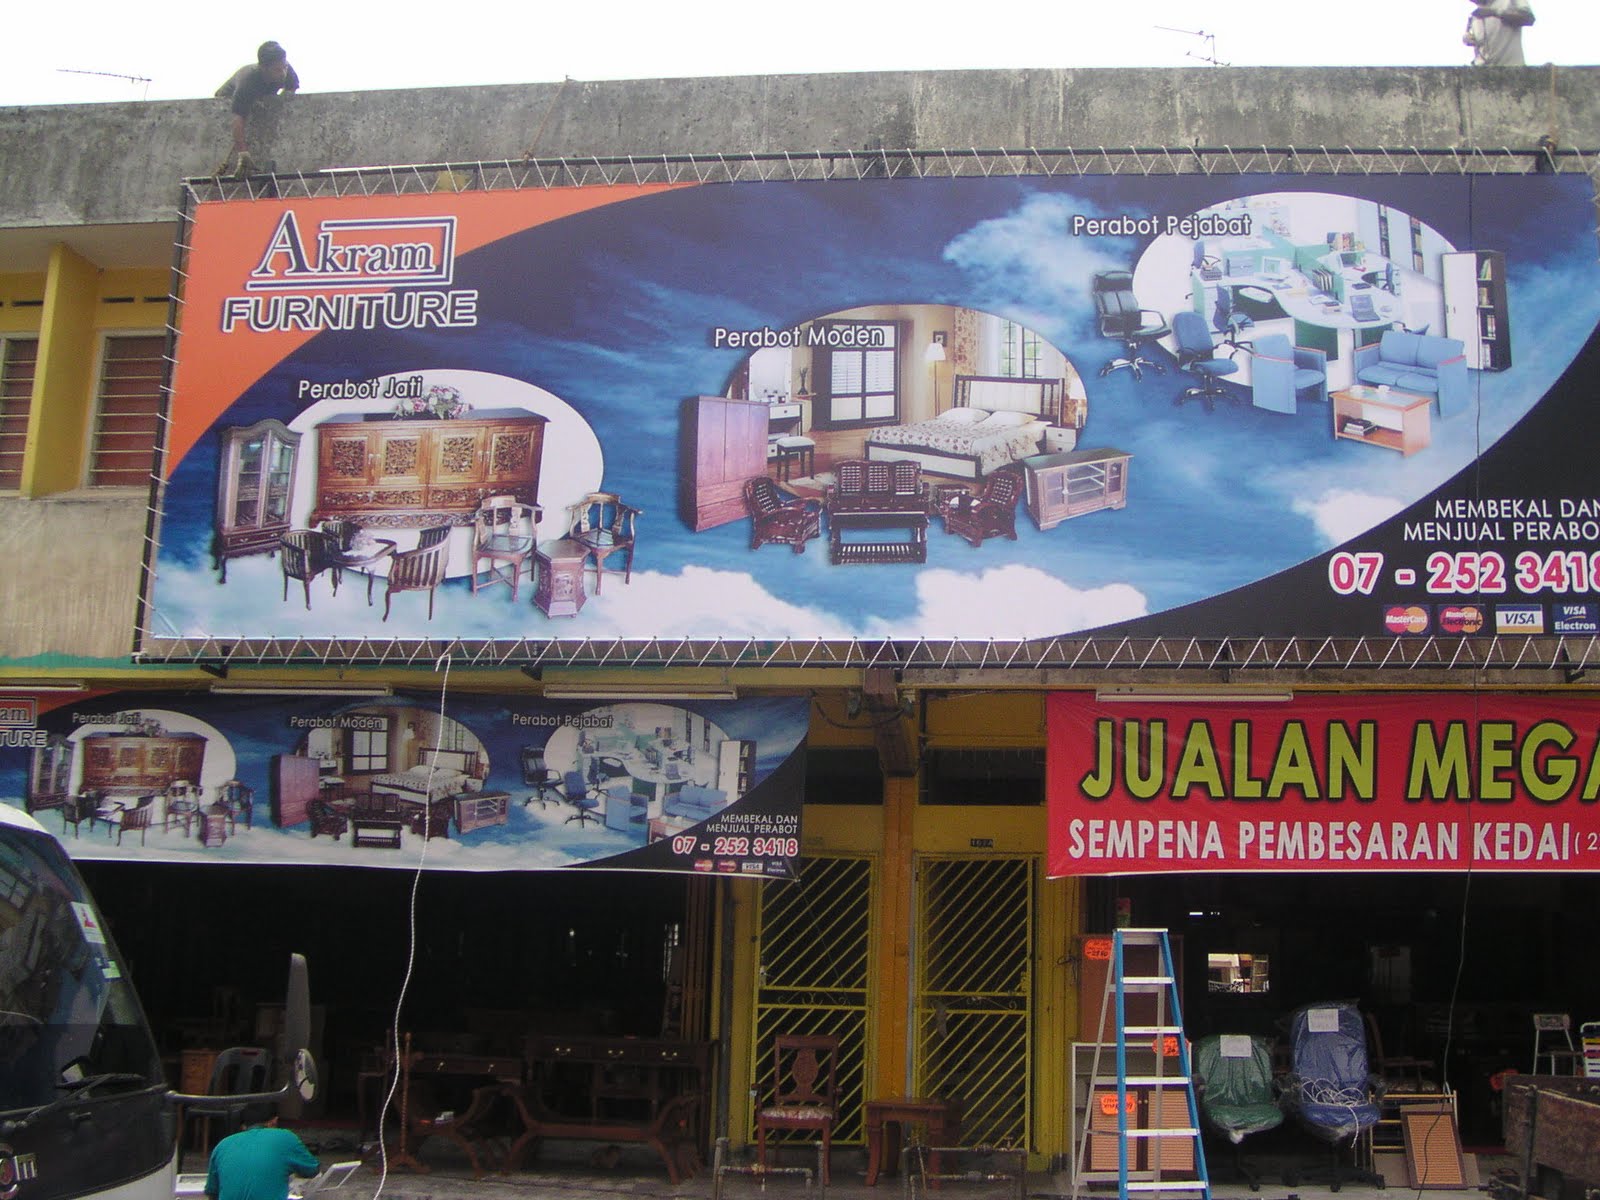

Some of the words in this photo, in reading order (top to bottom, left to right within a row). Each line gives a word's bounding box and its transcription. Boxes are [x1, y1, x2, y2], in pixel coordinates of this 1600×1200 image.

[1073, 215, 1159, 236] Perabot
[1166, 215, 1252, 240] Pejabat
[252, 210, 434, 277] Akram
[222, 290, 478, 332] FURNITURE
[715, 327, 802, 349] Perabot
[808, 325, 885, 347] Moden
[298, 378, 381, 399] Perabot
[384, 376, 422, 398] Jati
[1435, 499, 1552, 518] MEMBEKAL
[1404, 522, 1505, 541] MENJUAL
[1513, 521, 1600, 541] PERABO
[1328, 551, 1384, 595] 07
[1426, 551, 1507, 594] 252
[1504, 612, 1535, 624] VISA
[1563, 605, 1587, 615] VISA
[1385, 615, 1427, 625] MasterCard
[1554, 621, 1597, 631] Electron
[72, 712, 119, 724] Perabot
[290, 715, 339, 729] Perabot
[340, 716, 383, 730] Moden
[512, 713, 561, 727] Perabot
[564, 714, 614, 730] Pejabat
[1079, 719, 1377, 801] JUALAN
[720, 814, 772, 824] MEMBEKAL
[776, 814, 798, 824] DAN
[706, 824, 751, 833] MENJUAL
[753, 824, 798, 834] PERABOT
[672, 835, 697, 854] 07
[714, 837, 749, 856] 252
[753, 837, 798, 856] 3418
[1068, 818, 1225, 860] SEMPENA
[1239, 820, 1459, 861] PEMBESARAN
[1473, 822, 1569, 861] KEDAI
